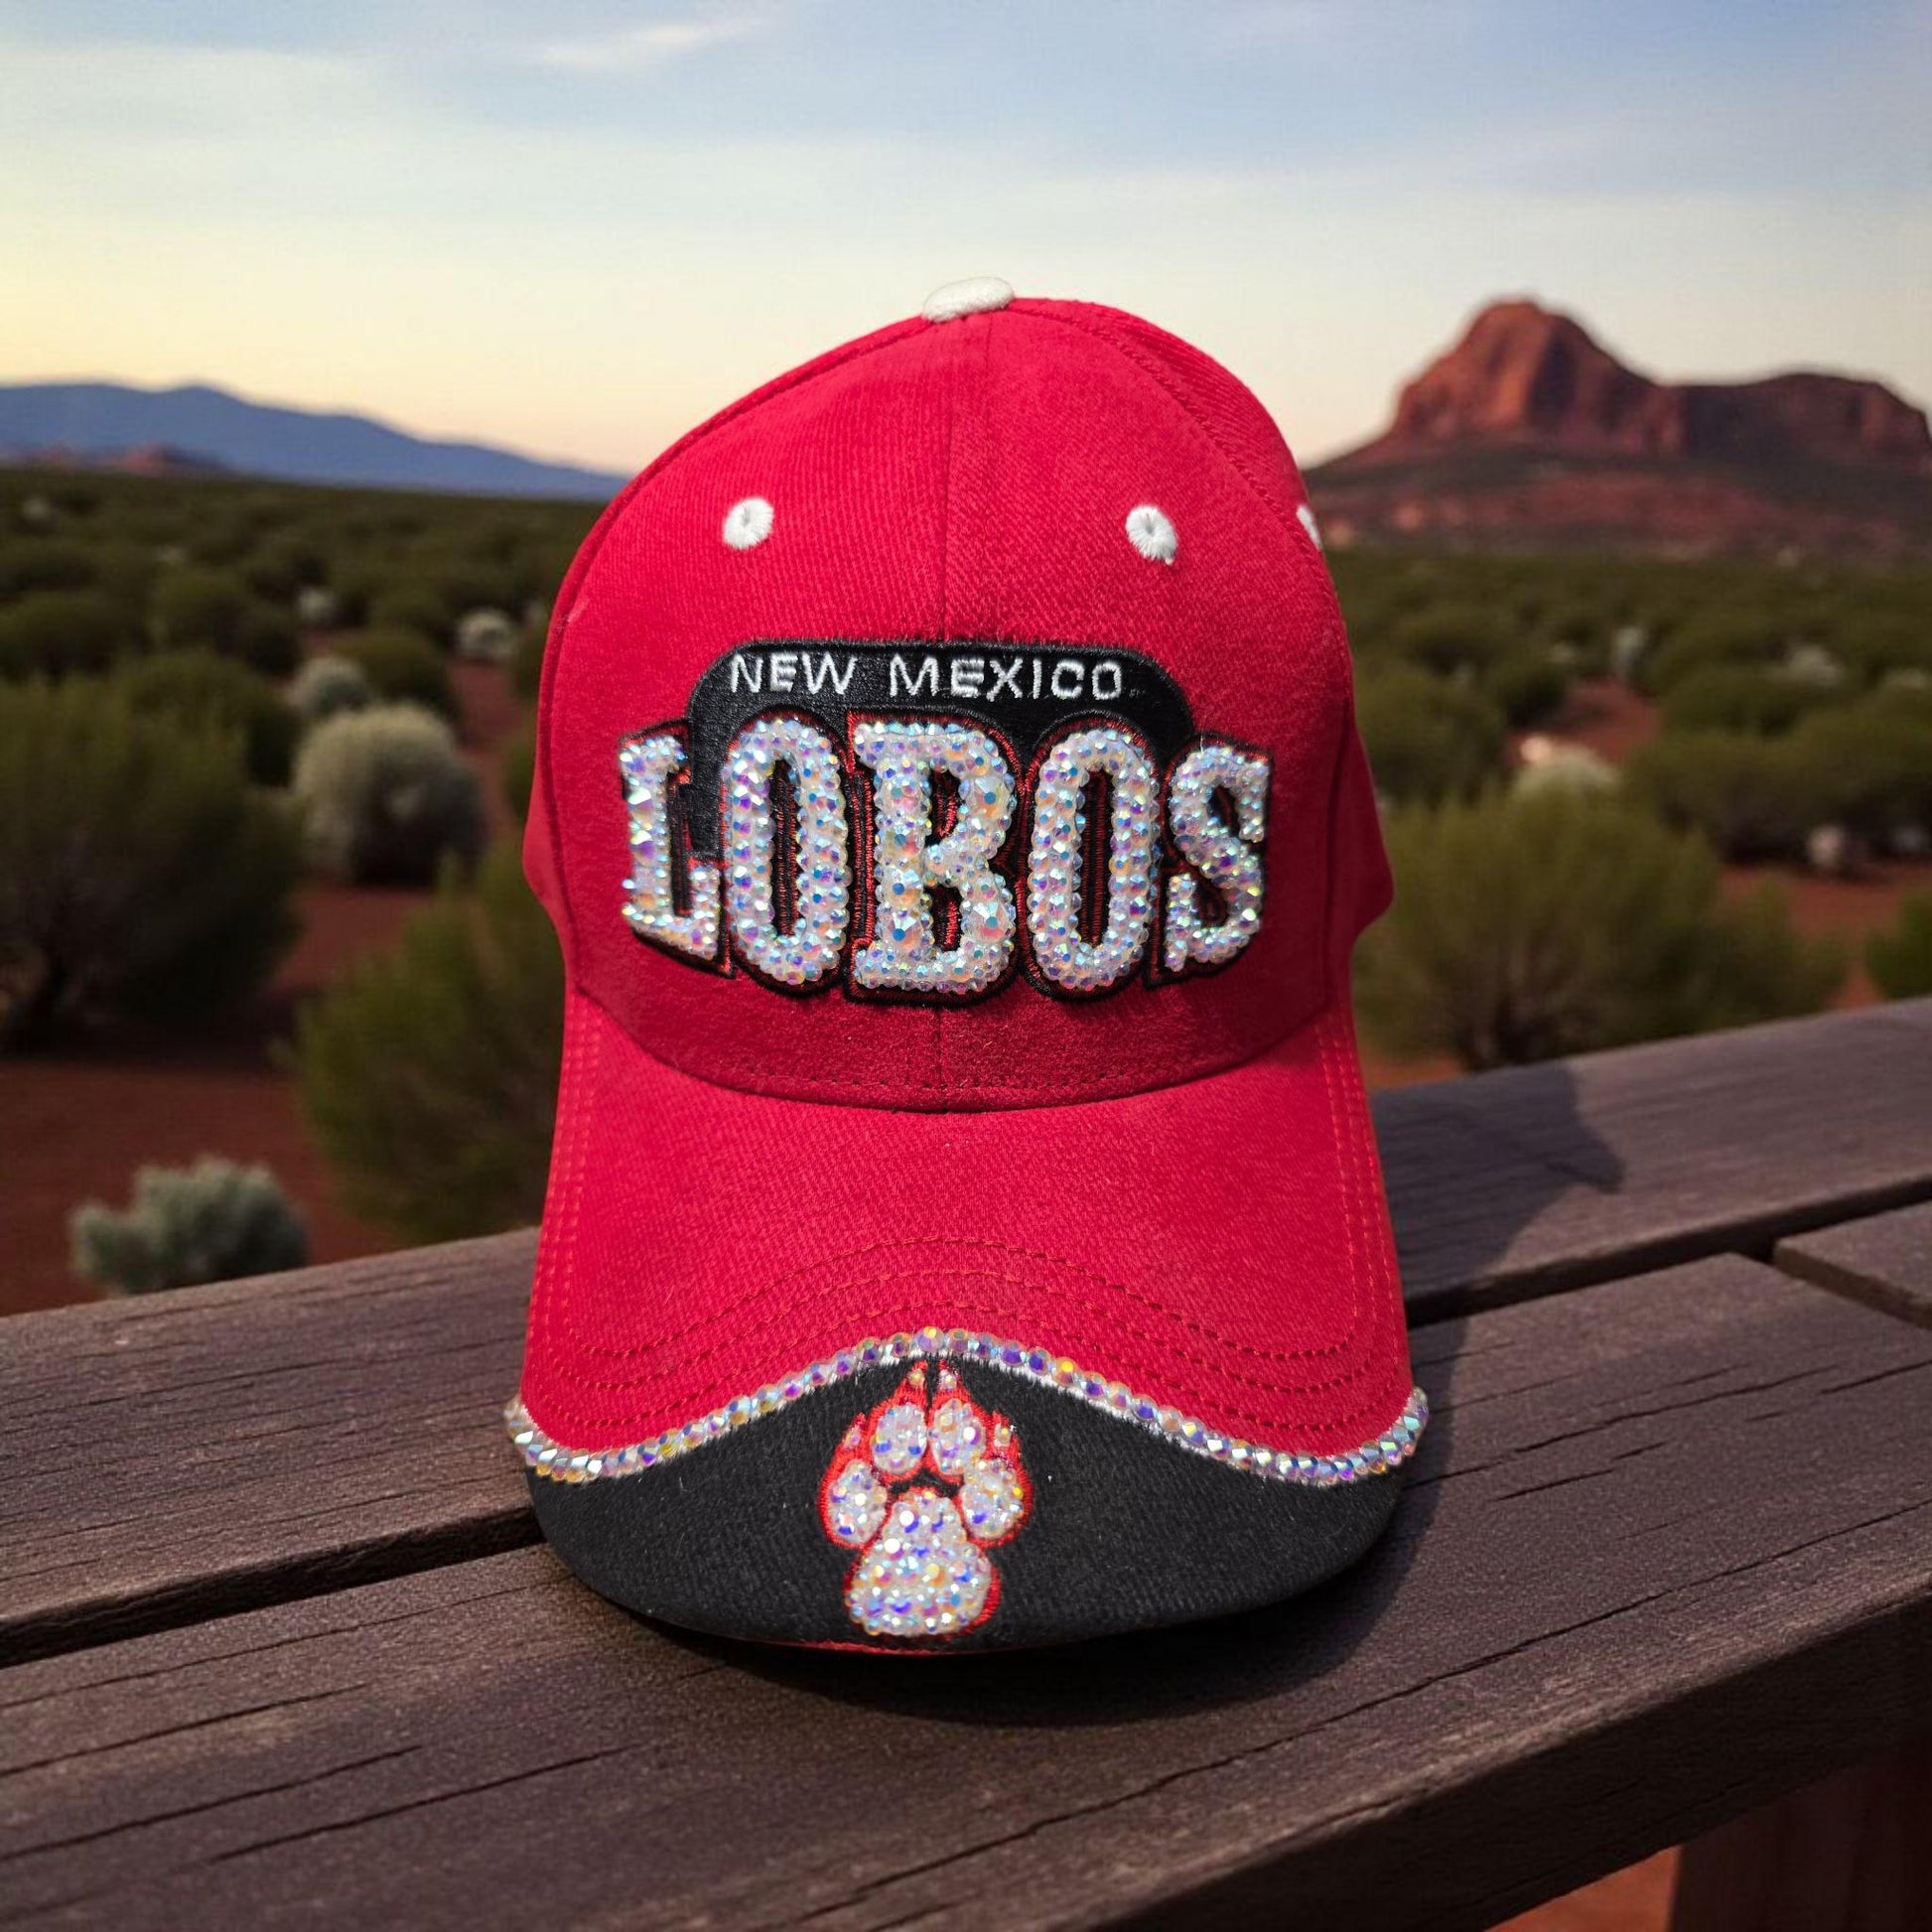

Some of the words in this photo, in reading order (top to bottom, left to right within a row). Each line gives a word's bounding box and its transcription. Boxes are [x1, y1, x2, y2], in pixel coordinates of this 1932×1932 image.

[729, 653, 859, 695] NEW
[889, 656, 1123, 701] MEXICO
[620, 718, 1271, 993] LOBOS
